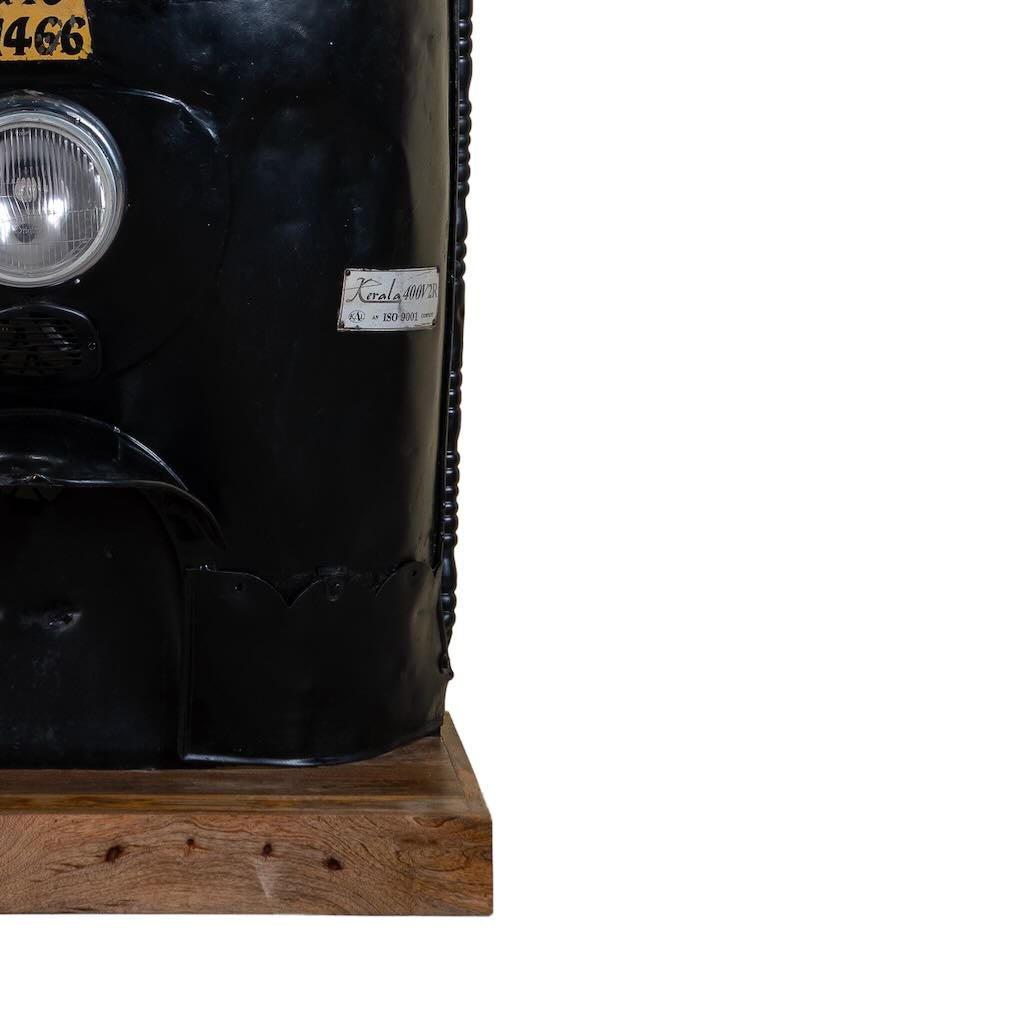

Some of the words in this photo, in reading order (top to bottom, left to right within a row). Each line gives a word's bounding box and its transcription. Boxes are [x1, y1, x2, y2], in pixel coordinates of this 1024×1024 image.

[346, 277, 401, 304] Kerala
[383, 312, 398, 322] ISO
[400, 312, 418, 322] 9001
